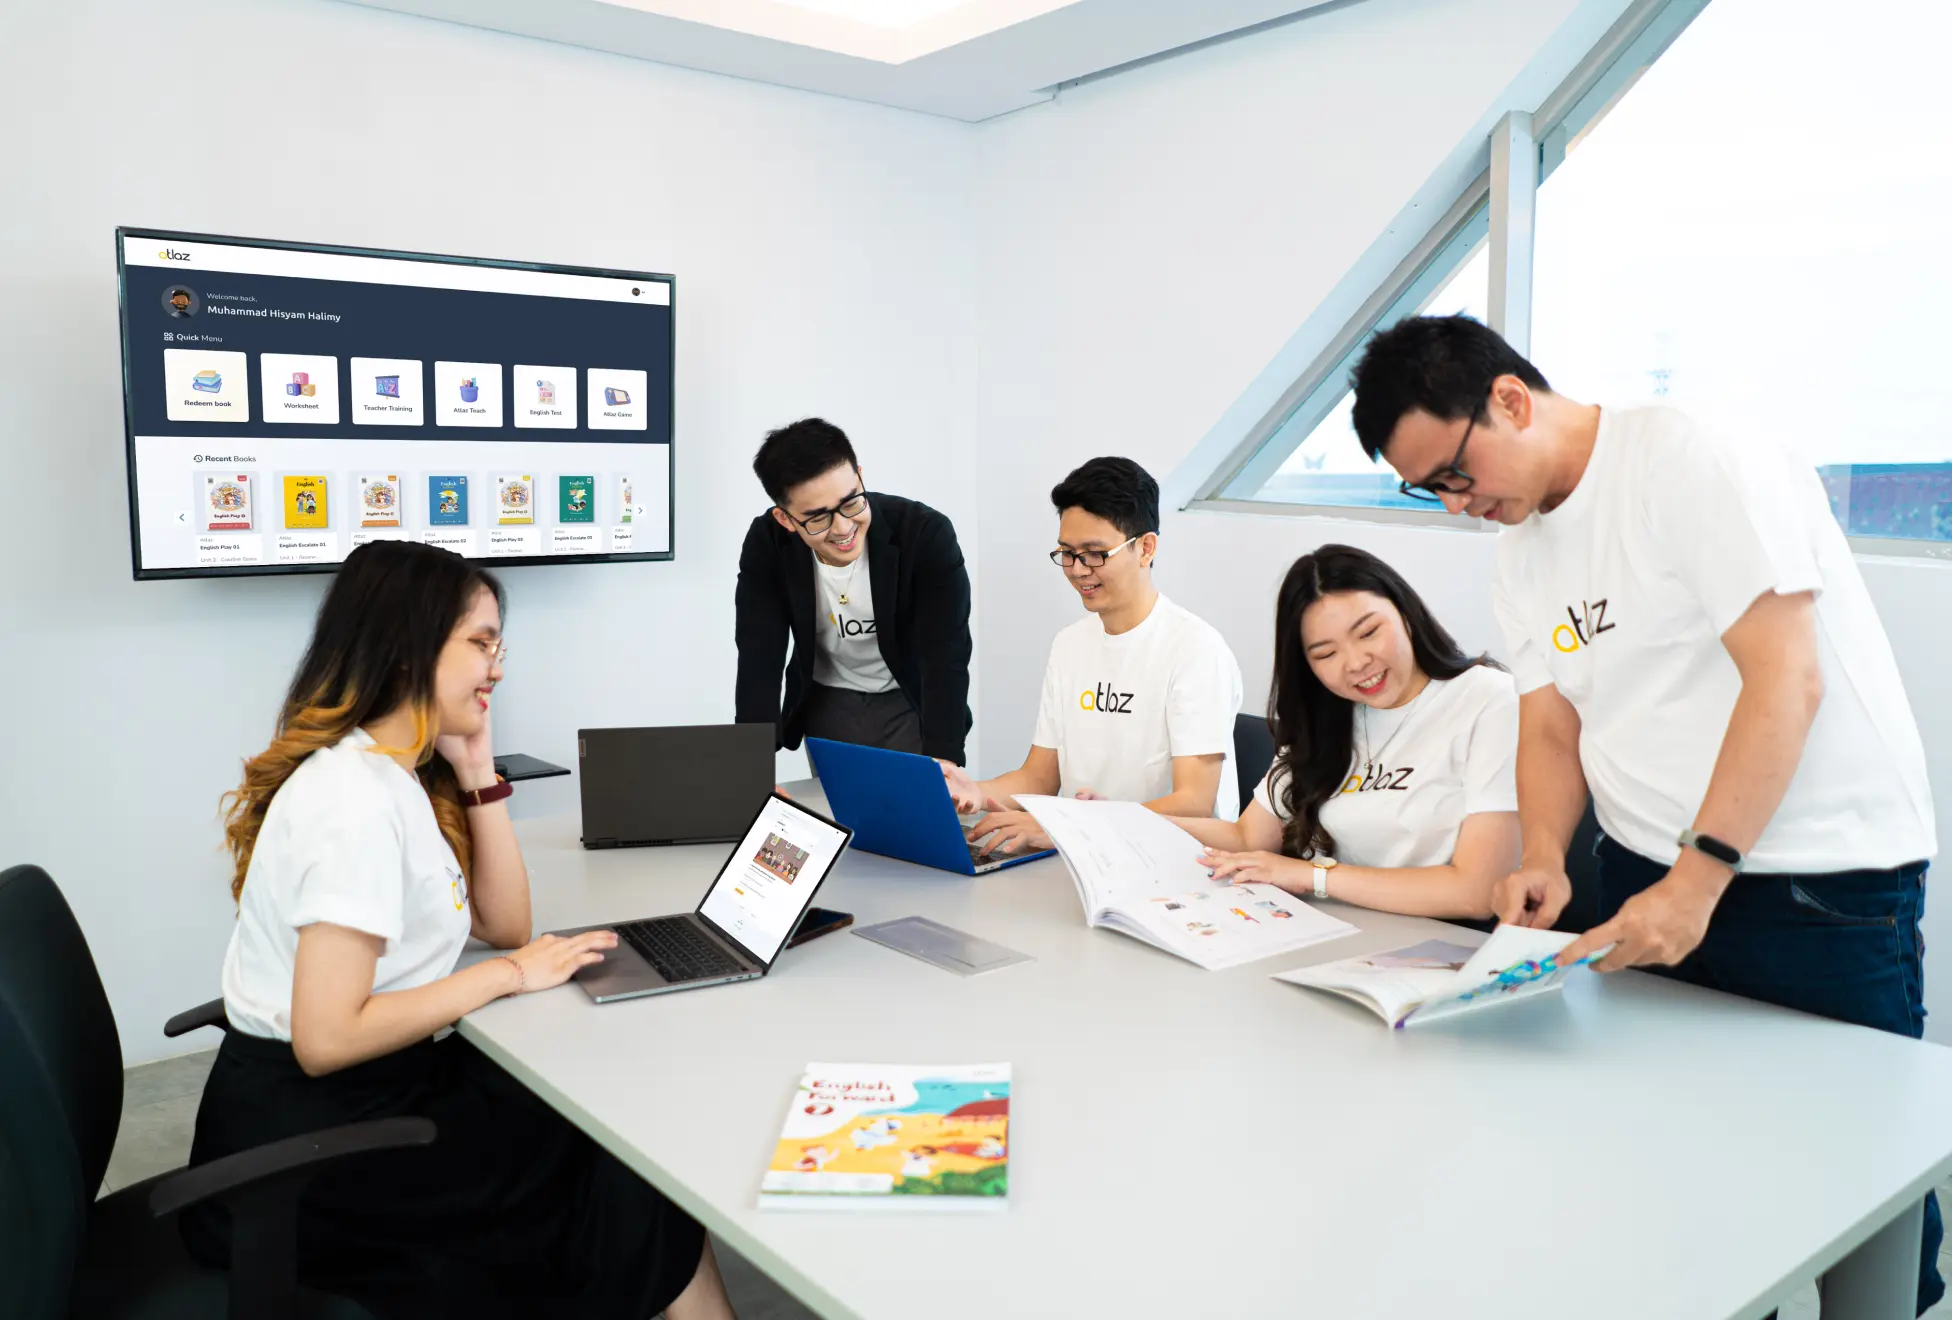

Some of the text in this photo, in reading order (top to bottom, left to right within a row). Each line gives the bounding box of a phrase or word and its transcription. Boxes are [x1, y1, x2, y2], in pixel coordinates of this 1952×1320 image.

[158, 248, 190, 261] atlaz
[206, 292, 238, 301] Welcome
[207, 305, 341, 323] Muhammad Hisyam Halimy
[176, 333, 223, 343] Quick Menu
[184, 399, 232, 408] Redeem book
[283, 402, 319, 410] Worksheet
[363, 404, 413, 413] Teacher Training
[834, 612, 876, 638] laz
[1079, 681, 1134, 714] atlaz
[1341, 763, 1414, 794] atlaz
[812, 1080, 892, 1092] English
